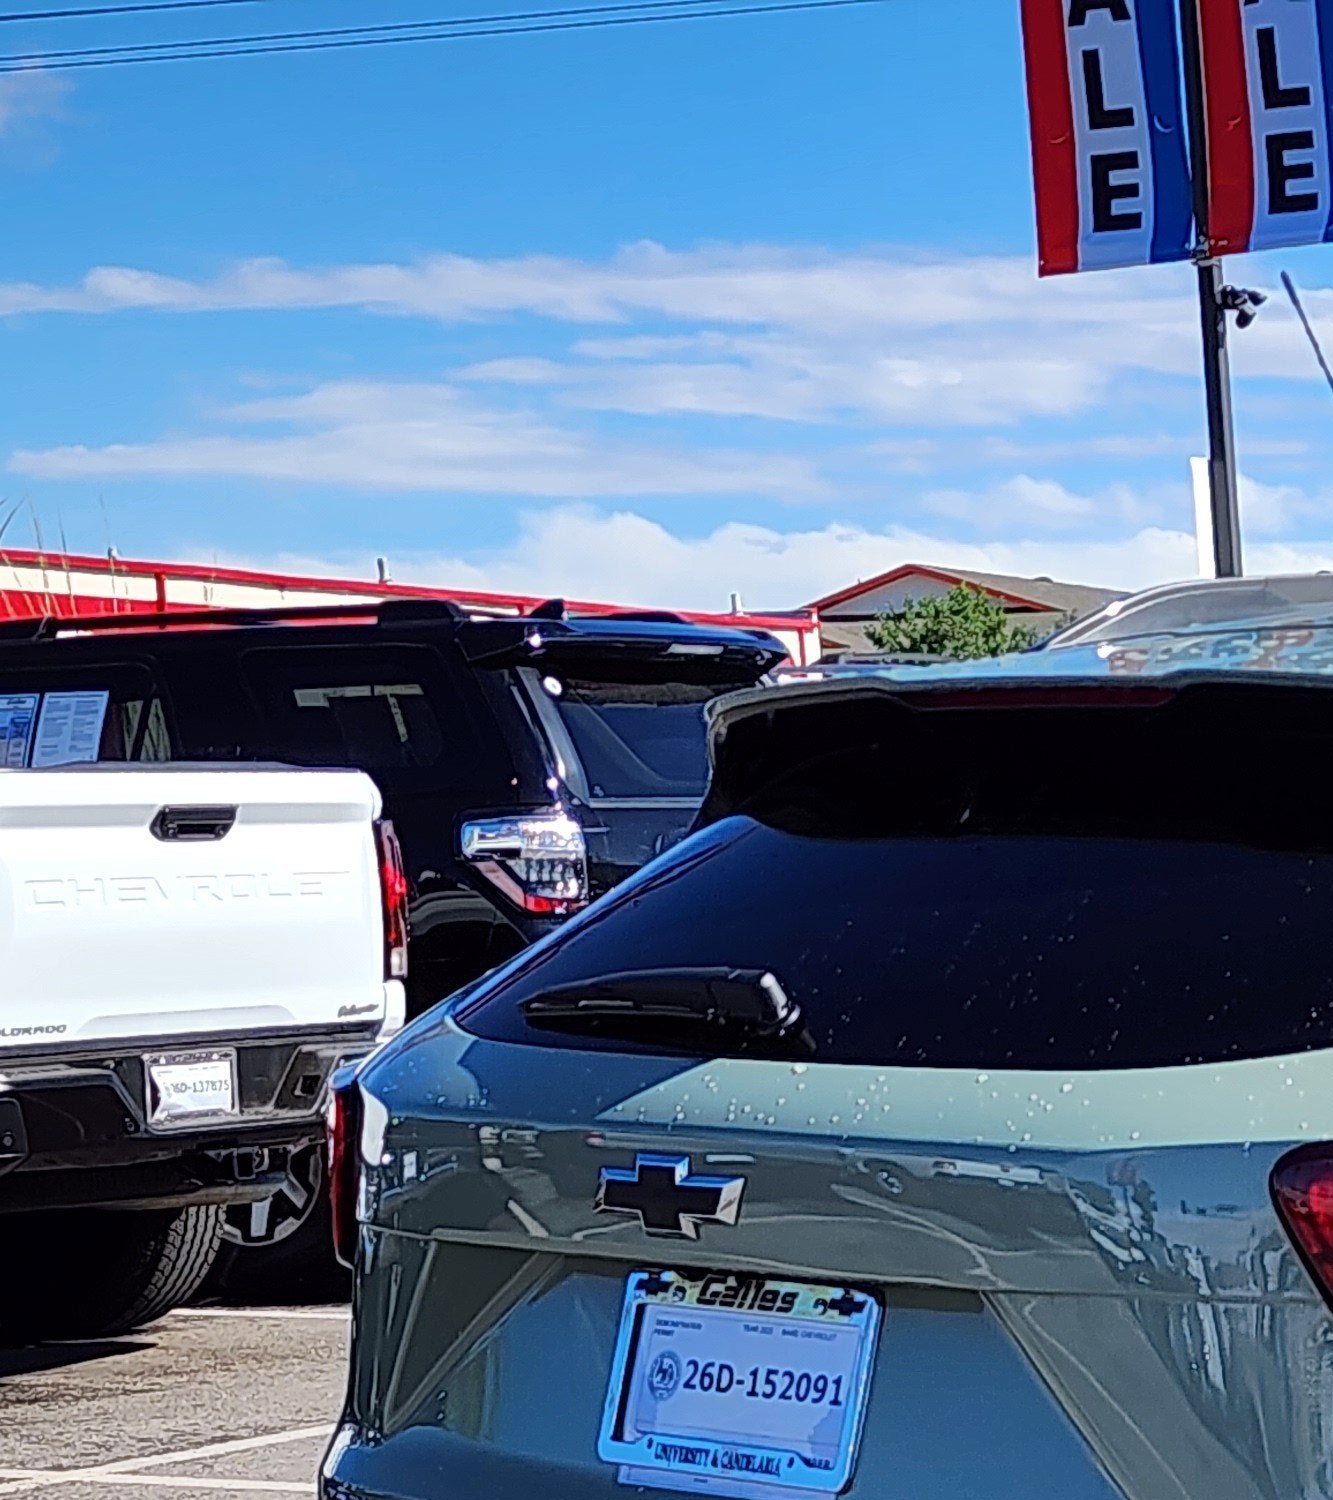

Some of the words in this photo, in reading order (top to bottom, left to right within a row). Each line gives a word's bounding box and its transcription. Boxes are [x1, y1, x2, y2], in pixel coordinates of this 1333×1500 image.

[1244, 0, 1319, 215] LE
[24, 870, 350, 905] CHEVROLE
[0, 1024, 67, 1037] LORADO
[697, 1275, 799, 1313] Galles
[683, 1359, 843, 1406] 26D-152091
